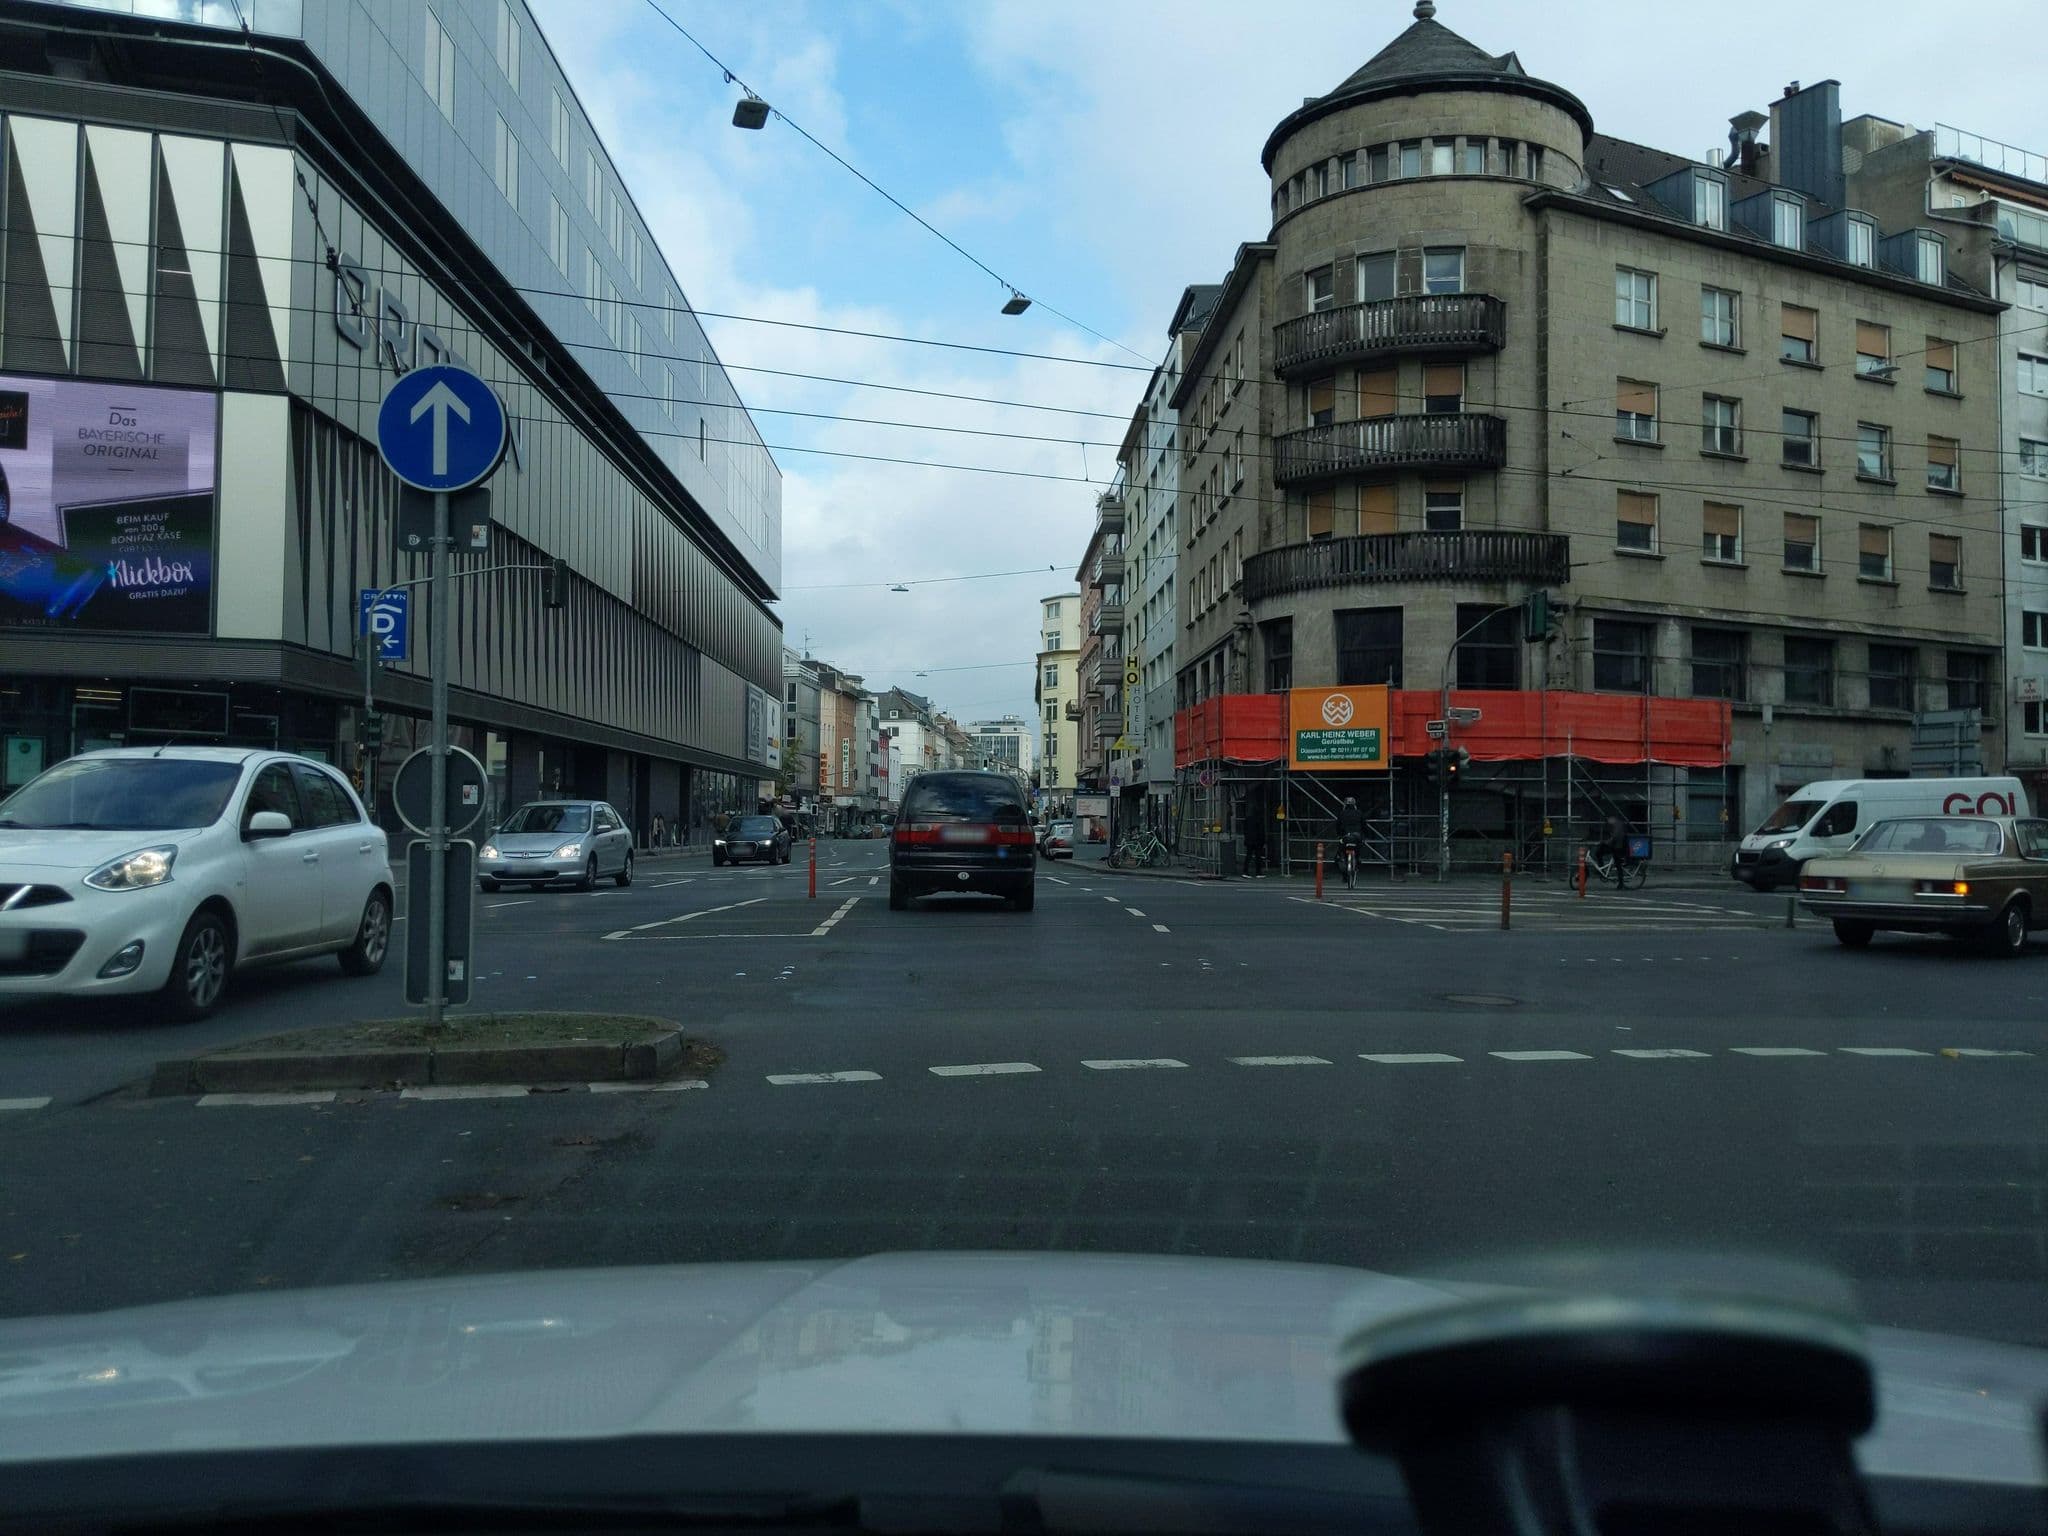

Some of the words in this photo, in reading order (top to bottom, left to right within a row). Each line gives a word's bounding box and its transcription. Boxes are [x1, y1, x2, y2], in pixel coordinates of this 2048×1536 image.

[109, 412, 136, 427] Das
[79, 427, 166, 445] BAYERISCHE
[84, 444, 159, 460] ORIGINAL
[116, 515, 141, 524] BEIM
[143, 512, 169, 522] KAUF
[141, 523, 159, 533] 300
[111, 533, 155, 544] BONIFAZ
[107, 556, 194, 588] Klickbox
[129, 590, 159, 600] GRATIS
[1133, 688, 1142, 733] HOTEL
[1300, 731, 1321, 739] KARL
[1322, 730, 1346, 739] HEINZ
[1347, 730, 1376, 738] WEBER
